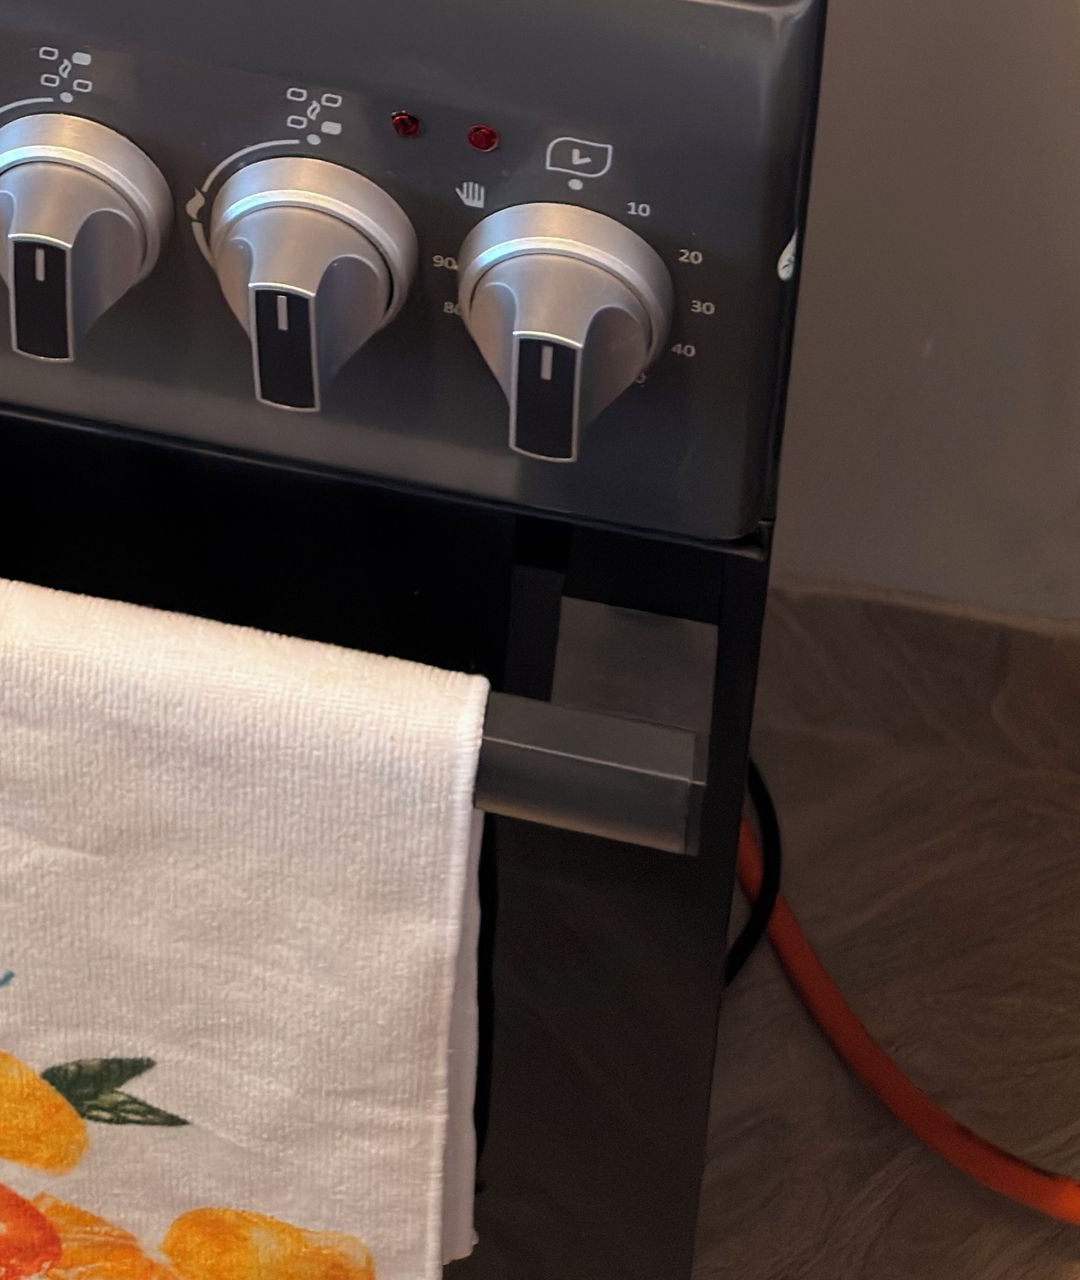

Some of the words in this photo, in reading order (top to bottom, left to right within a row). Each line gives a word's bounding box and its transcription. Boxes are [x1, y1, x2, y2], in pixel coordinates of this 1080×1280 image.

[627, 201, 651, 217] 10
[432, 254, 458, 270] 90
[678, 249, 703, 265] 20
[690, 300, 716, 316] 30
[671, 343, 696, 358] 40
